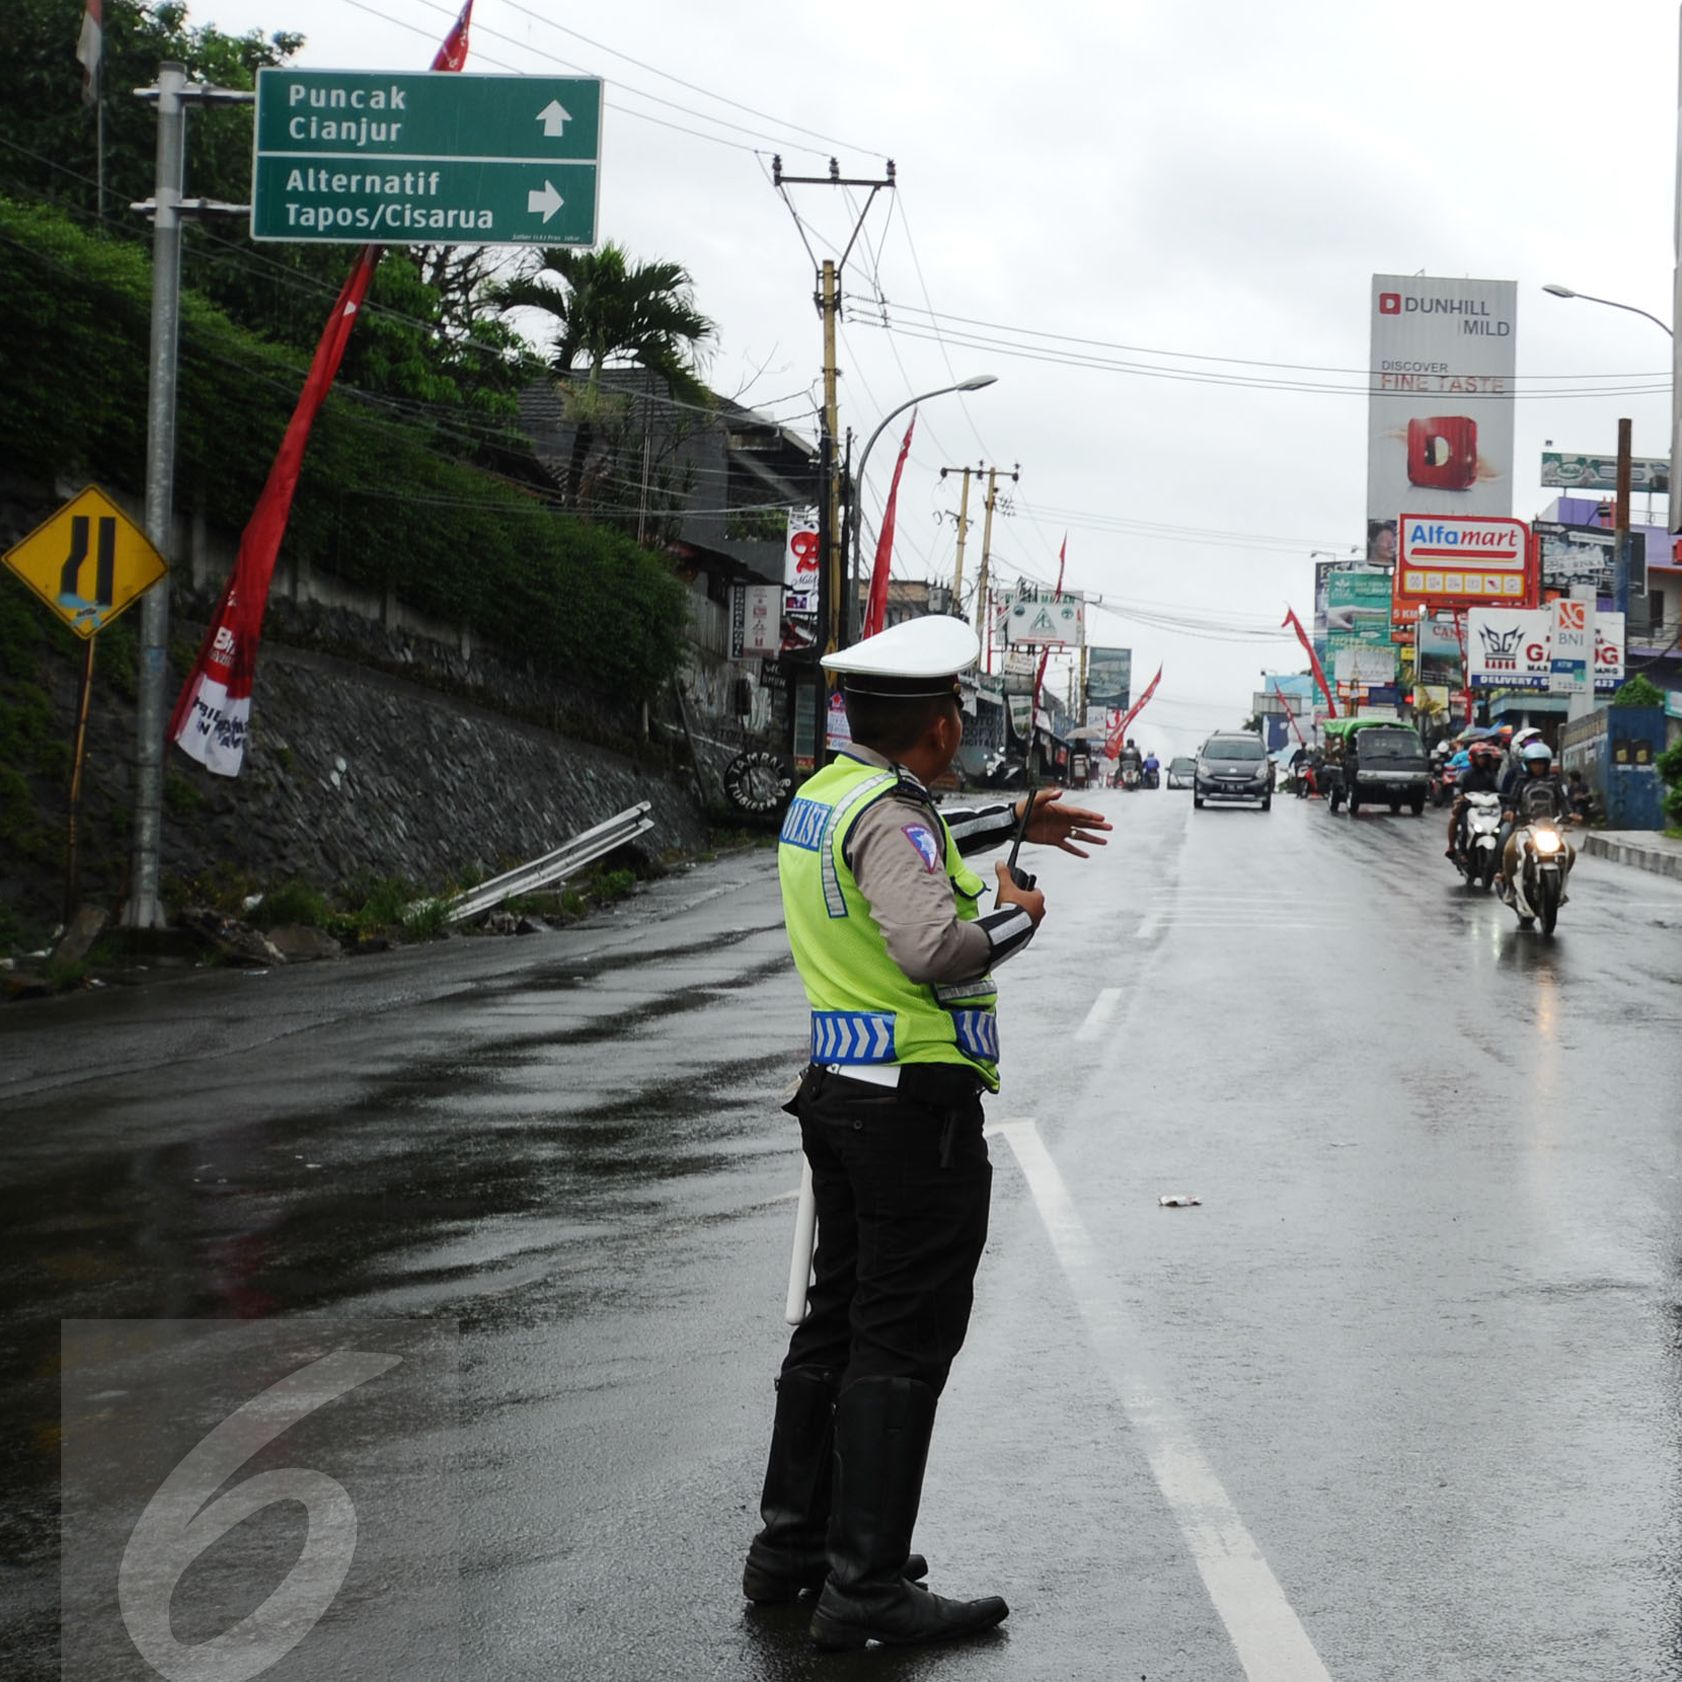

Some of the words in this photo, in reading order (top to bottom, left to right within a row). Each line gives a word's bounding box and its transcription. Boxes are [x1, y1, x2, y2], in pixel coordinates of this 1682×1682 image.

[288, 83, 406, 110] Puncak
[288, 115, 402, 146] Cianjur
[285, 168, 441, 196] Alternatif
[285, 203, 494, 231] Tapos/Cisarua
[1404, 297, 1491, 316] DUNHILL
[1463, 320, 1511, 337] MILD
[1381, 360, 1449, 374] DISCOVER
[1381, 373, 1429, 391] FINE
[1440, 376, 1505, 394] TASTE
[1410, 524, 1518, 547] Alfamart
[1558, 632, 1584, 647] BNI
